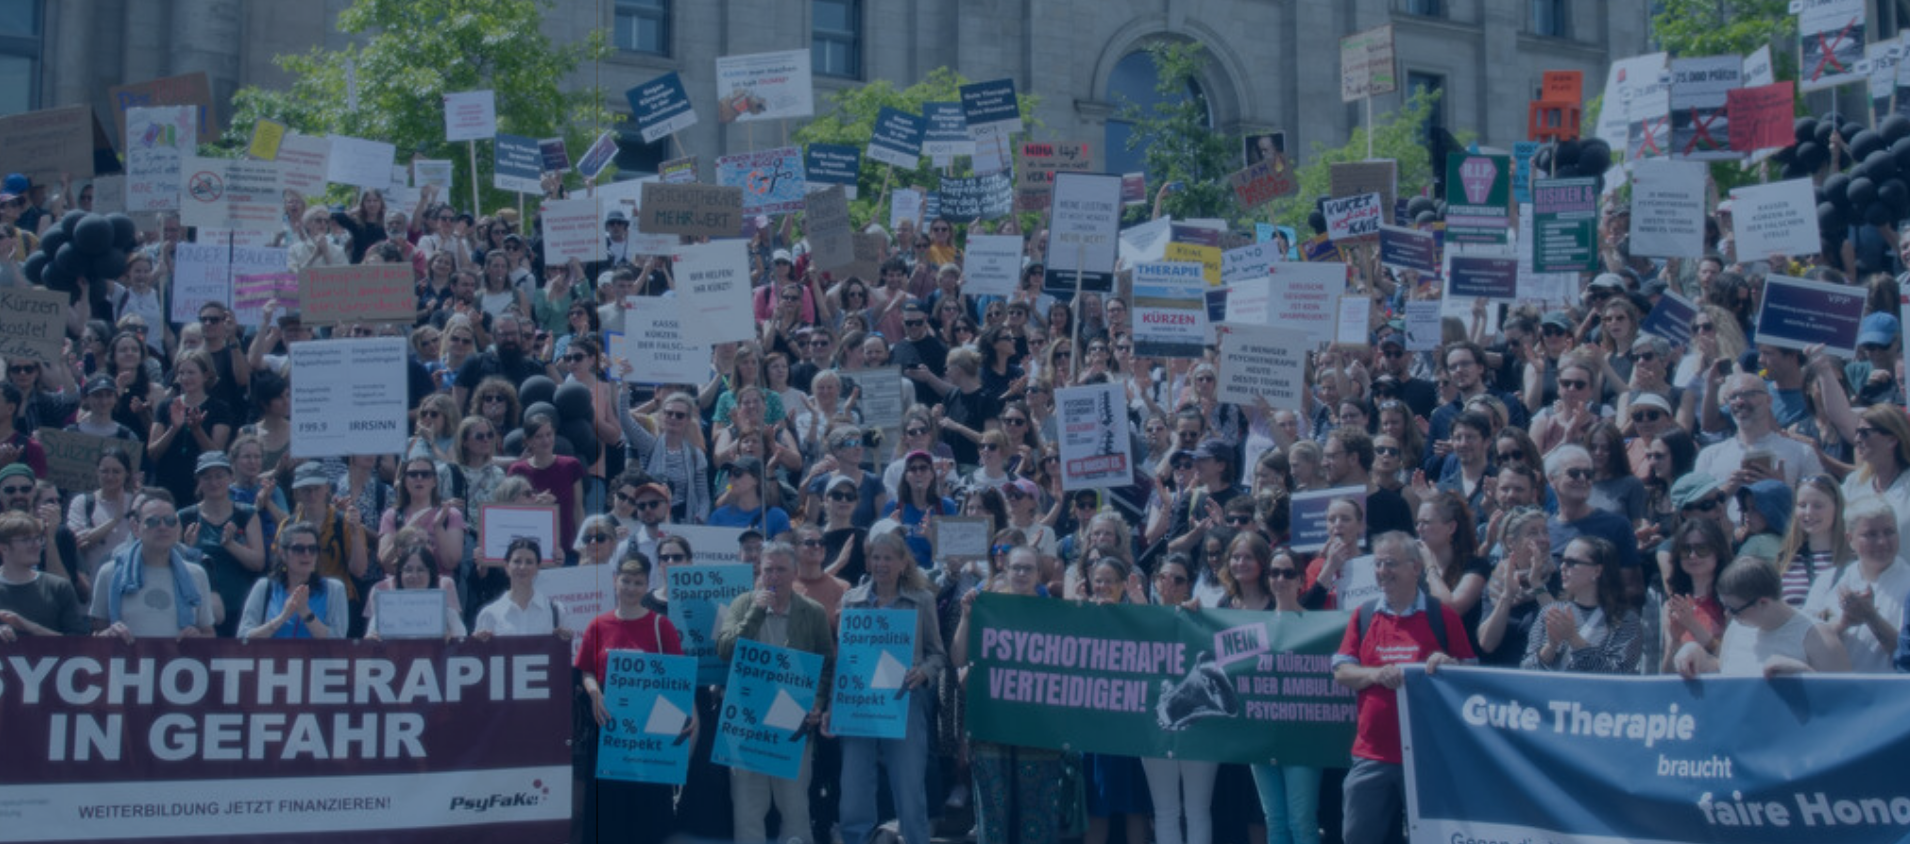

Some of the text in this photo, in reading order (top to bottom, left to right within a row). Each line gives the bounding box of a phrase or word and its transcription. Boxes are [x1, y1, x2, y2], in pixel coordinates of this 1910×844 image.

[1674, 72, 1707, 83] 75.000
[648, 186, 742, 208] PSYCHOTHERAPIE
[1535, 187, 1582, 203] RISIKEN
[178, 247, 221, 263] KINDER
[1137, 264, 1201, 278] THERAPIE
[1, 291, 59, 316] Kürzen
[1827, 293, 1852, 305] VPP
[653, 321, 680, 330] KASSE
[1142, 311, 1196, 325] KÜRZEN
[645, 330, 678, 340] KÜRZEN
[637, 341, 655, 351] DER
[1250, 346, 1287, 357] WENIGER
[654, 352, 682, 361] STELLE
[1228, 354, 1298, 368] PSYCHOTHERAPIE
[1246, 366, 1271, 376] HEUTE
[1232, 374, 1290, 387] DESTO TEURER
[1226, 385, 1248, 394] WIRD
[350, 419, 397, 432] IRRSINN
[671, 570, 723, 586] 100 %
[573, 603, 602, 614] HEUTE
[844, 614, 890, 630] 100 %
[689, 629, 704, 643] %
[842, 631, 910, 647] Sparpolitik
[1221, 628, 1261, 657] NEIN
[739, 644, 791, 671] 100 %
[980, 627, 1187, 676] PSYCHOTHERAPIE
[612, 656, 667, 677] 100 %
[1257, 654, 1275, 673] ZU
[0, 654, 551, 706] YCHOTHERAPIE
[610, 672, 692, 692] Sparpolitik
[734, 661, 814, 690] Sparpolitik
[838, 674, 865, 691] 0 %
[989, 666, 1150, 713] VERTEIDIGEN!
[1236, 676, 1251, 694] IN
[1253, 677, 1279, 695] DER
[836, 691, 886, 708] Respekt
[725, 704, 757, 726] 0 %
[1246, 700, 1359, 722] PSYCHOTHERAPI
[621, 718, 638, 735] %
[1461, 694, 1697, 748] Gute Therapie
[48, 712, 427, 762] IN GEFAHR
[721, 721, 779, 745] Respekt
[603, 735, 663, 752] Respekt
[1656, 753, 1732, 780] braucht
[78, 796, 391, 820] WEITERBILDUNG JETZT FINANZIEREN!
[1697, 790, 1910, 827] faire Hono
